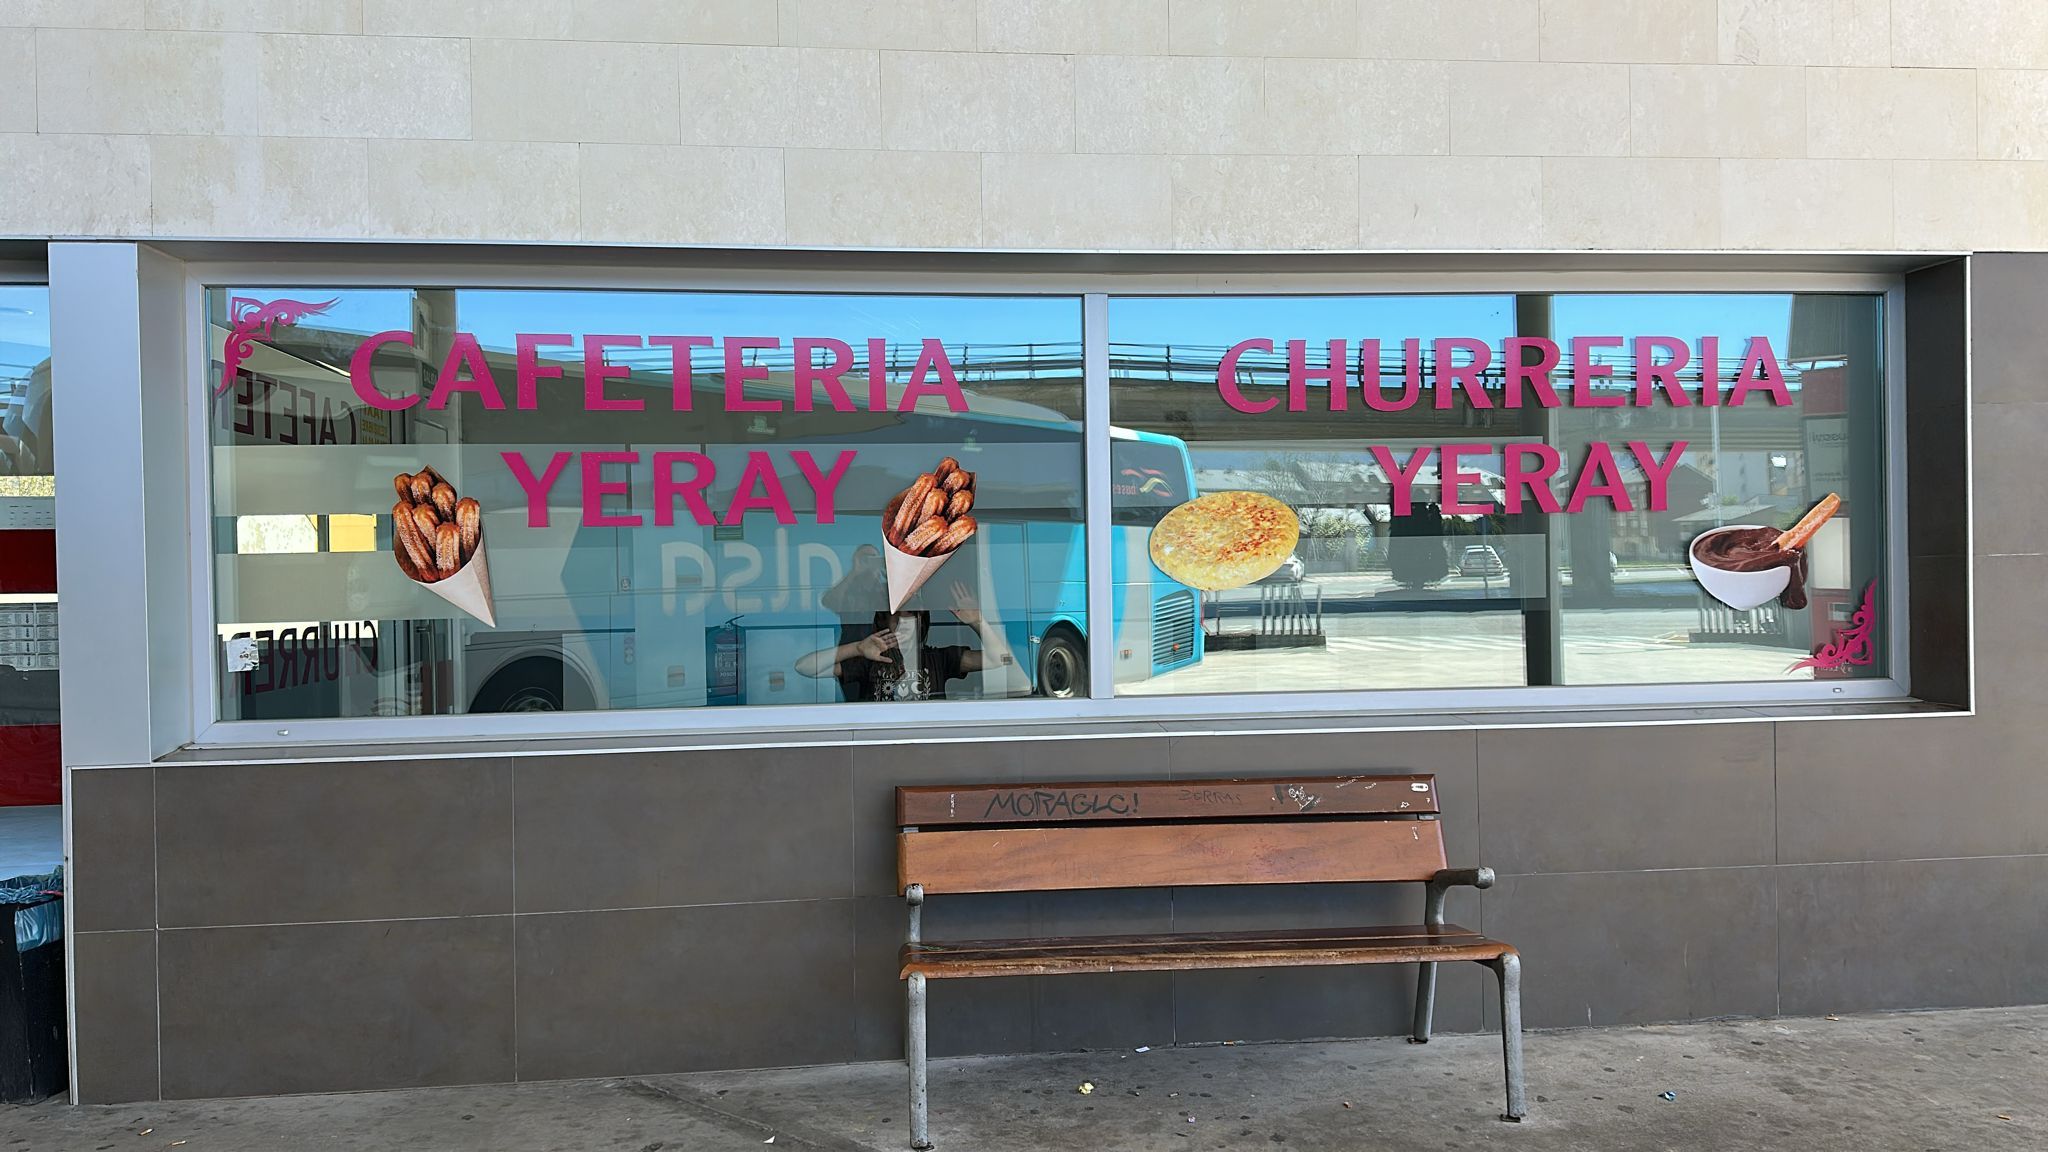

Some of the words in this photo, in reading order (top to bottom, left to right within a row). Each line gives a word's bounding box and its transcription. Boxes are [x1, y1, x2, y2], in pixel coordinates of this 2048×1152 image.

[350, 331, 970, 414] CAFETERIA
[1217, 336, 1794, 414] CHURRERIA
[501, 450, 858, 529] YERAY
[1371, 441, 1691, 519] YERAY
